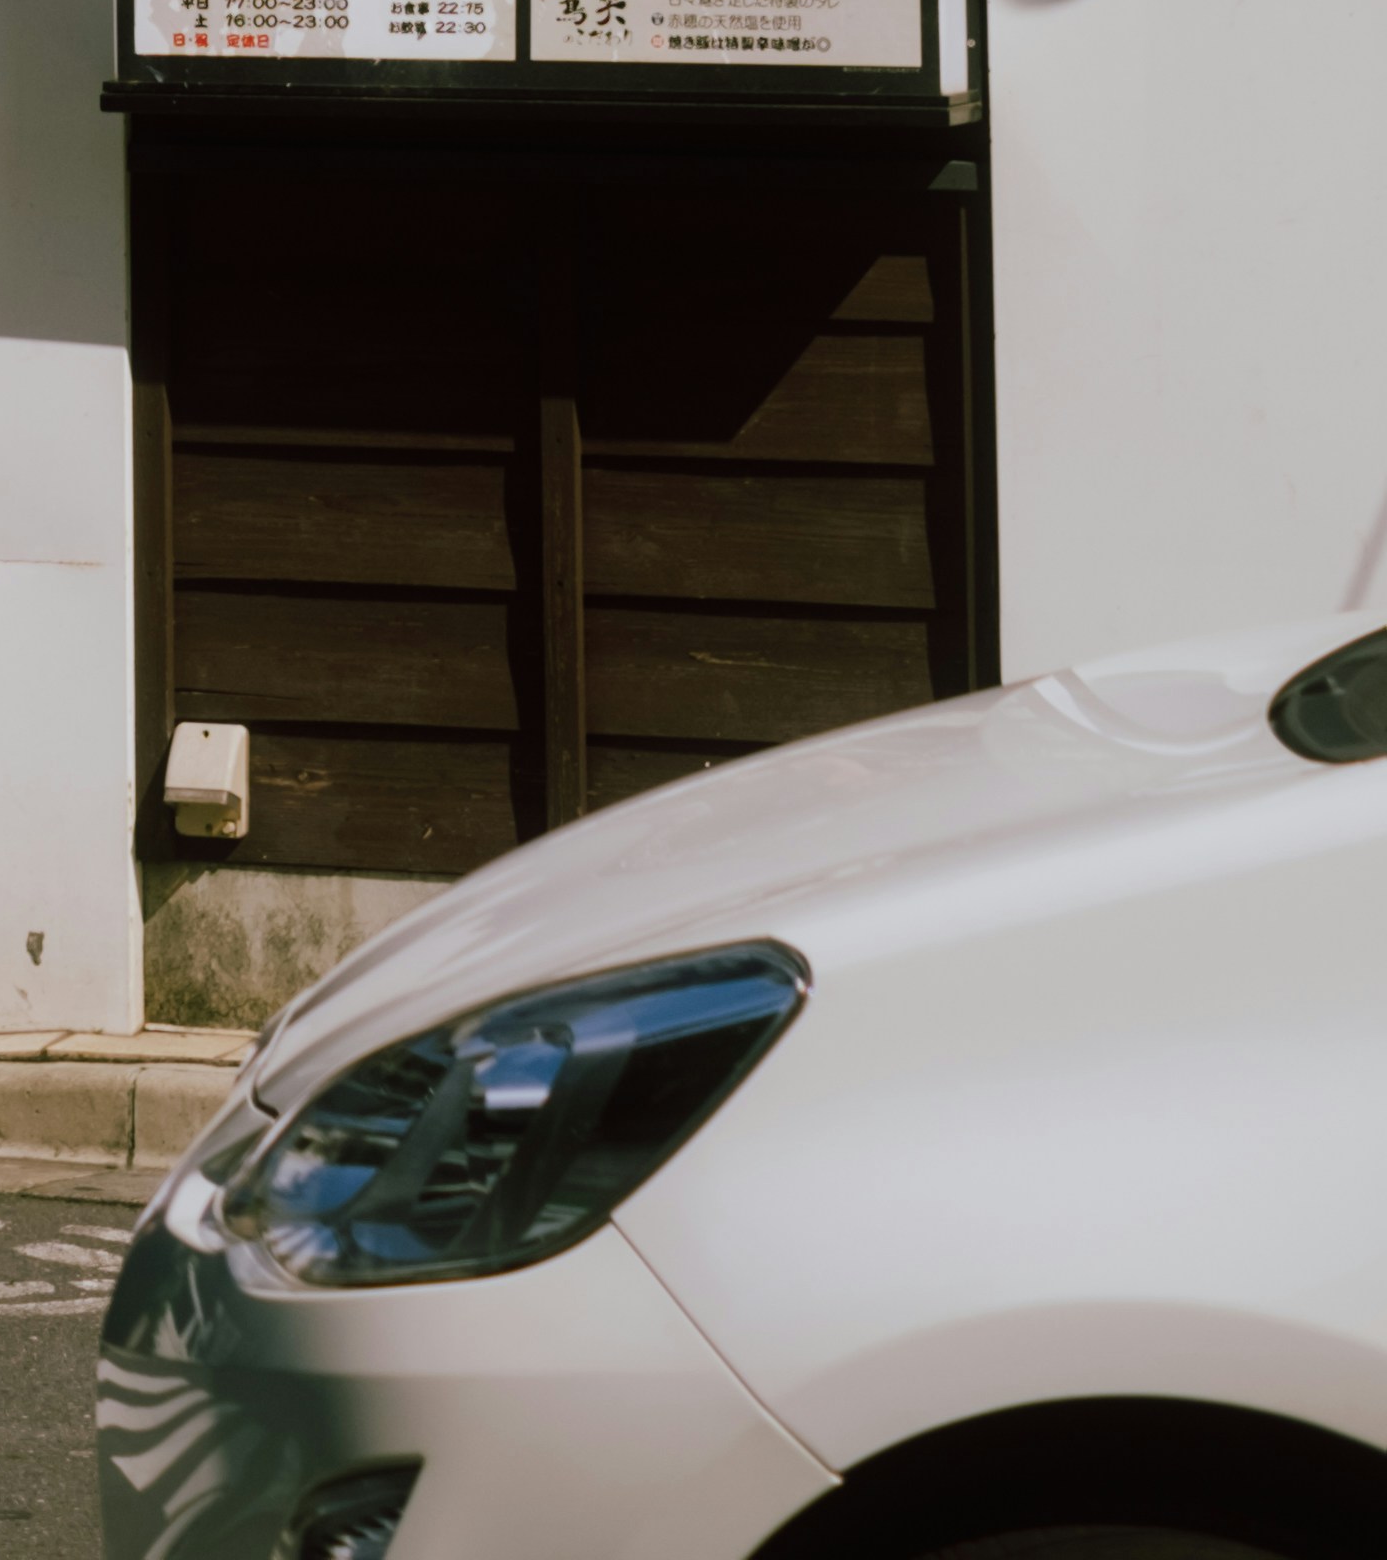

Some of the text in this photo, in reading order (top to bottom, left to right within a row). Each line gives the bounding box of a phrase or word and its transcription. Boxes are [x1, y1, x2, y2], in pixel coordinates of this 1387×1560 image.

[390, 1, 484, 16] お食事 22:15
[194, 13, 209, 29] 土
[435, 21, 486, 36] 22:30
[226, 34, 270, 49] 定休日
